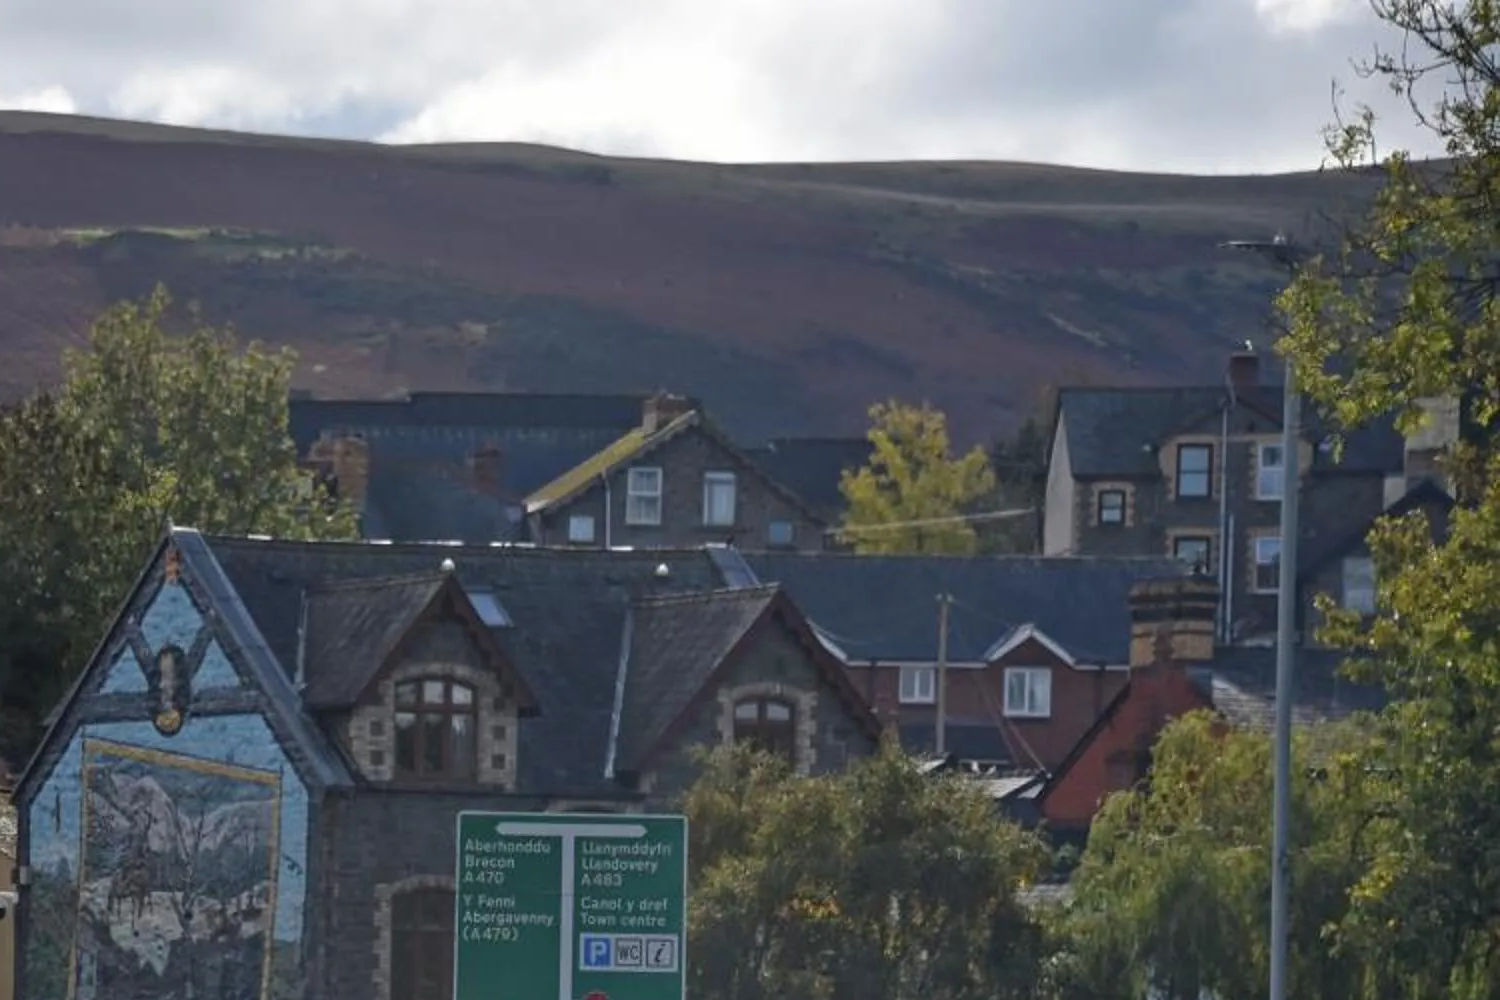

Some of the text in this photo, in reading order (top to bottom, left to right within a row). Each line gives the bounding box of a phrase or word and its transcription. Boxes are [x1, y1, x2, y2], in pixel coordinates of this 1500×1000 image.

[464, 839, 551, 853] Aberhonddu
[581, 841, 672, 857] Llanymddyfri
[465, 855, 515, 869] Brecon
[581, 858, 658, 873] Llandovery
[463, 894, 516, 908] Y Fenni
[581, 897, 668, 913] Canol y dref
[463, 911, 554, 927] Abergavenny
[580, 912, 667, 927] Town centre
[590, 941, 608, 965] P
[618, 945, 640, 961] WC
